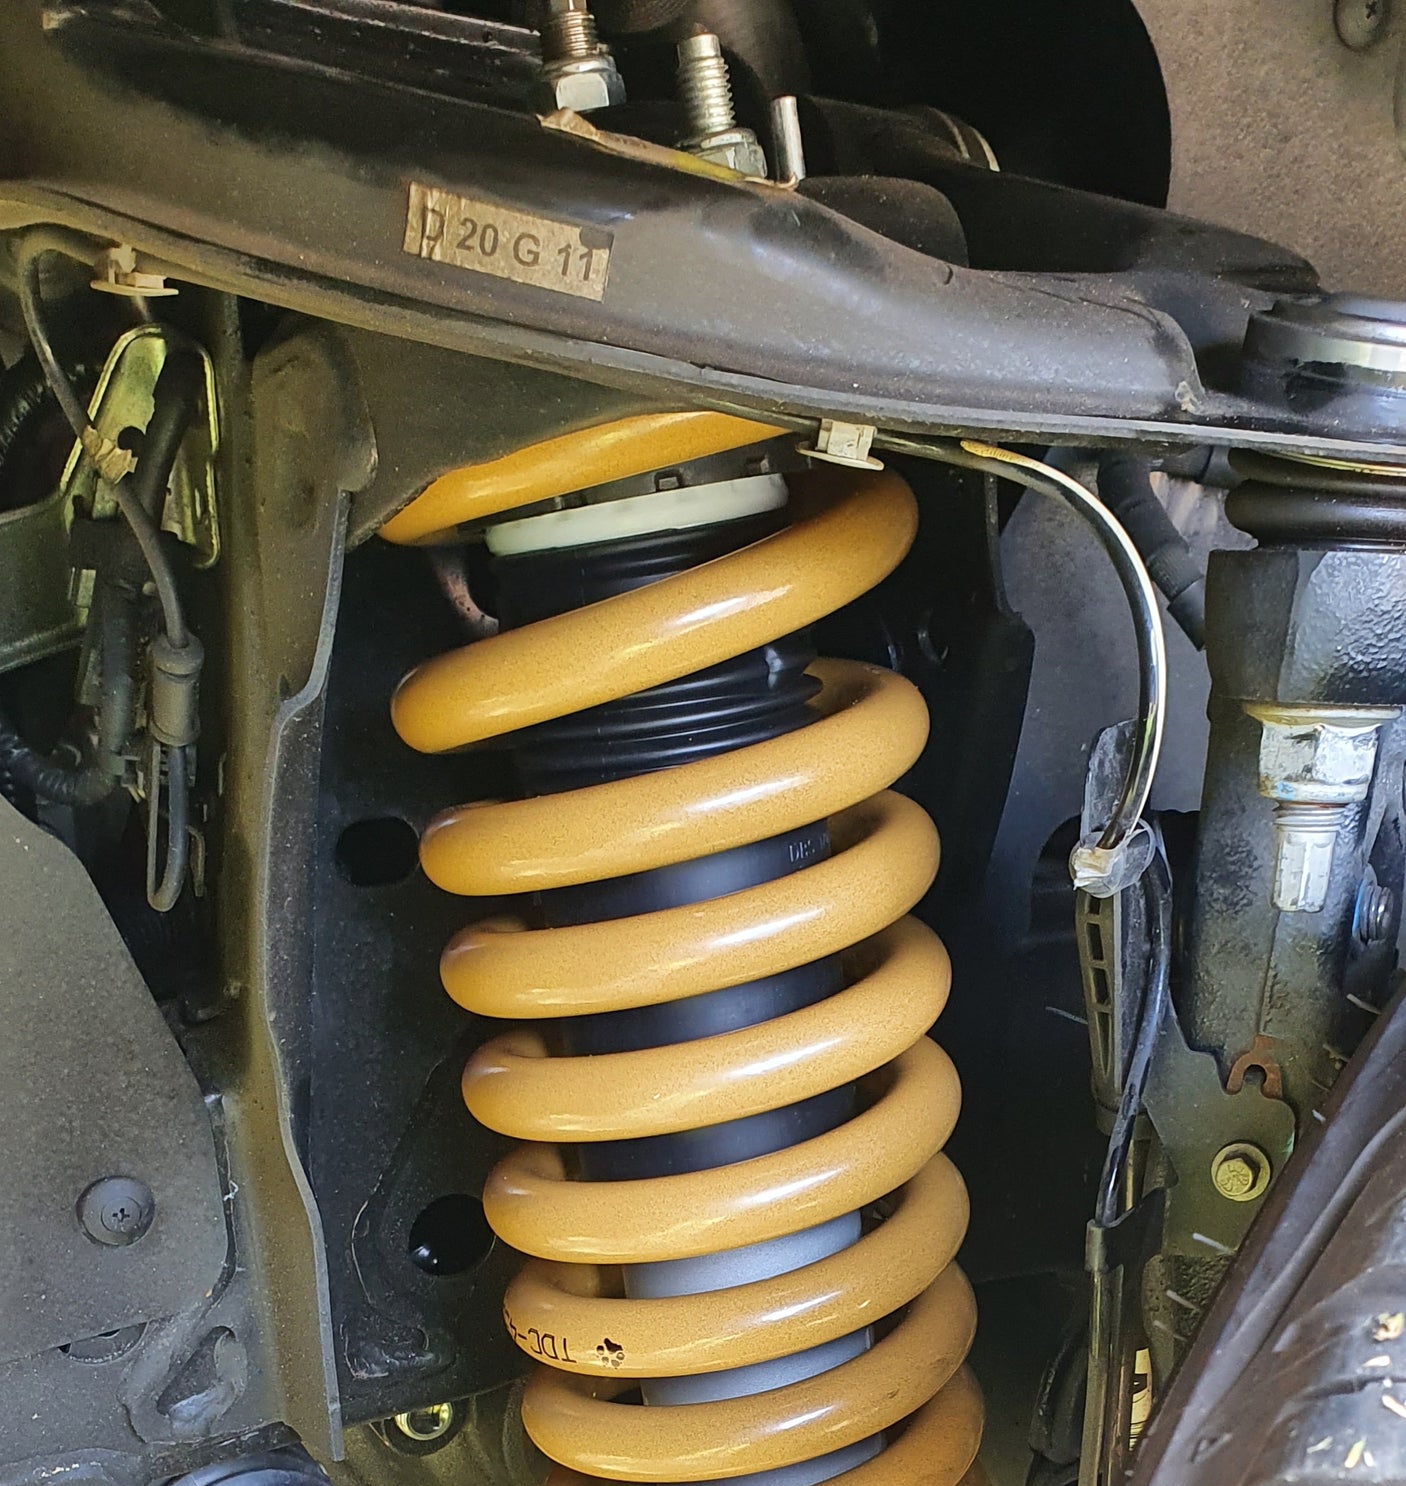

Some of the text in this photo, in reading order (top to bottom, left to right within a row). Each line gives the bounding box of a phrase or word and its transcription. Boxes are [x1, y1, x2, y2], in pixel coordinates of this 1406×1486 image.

[456, 218, 499, 256] 20
[513, 232, 541, 267] G
[557, 243, 594, 281] 11
